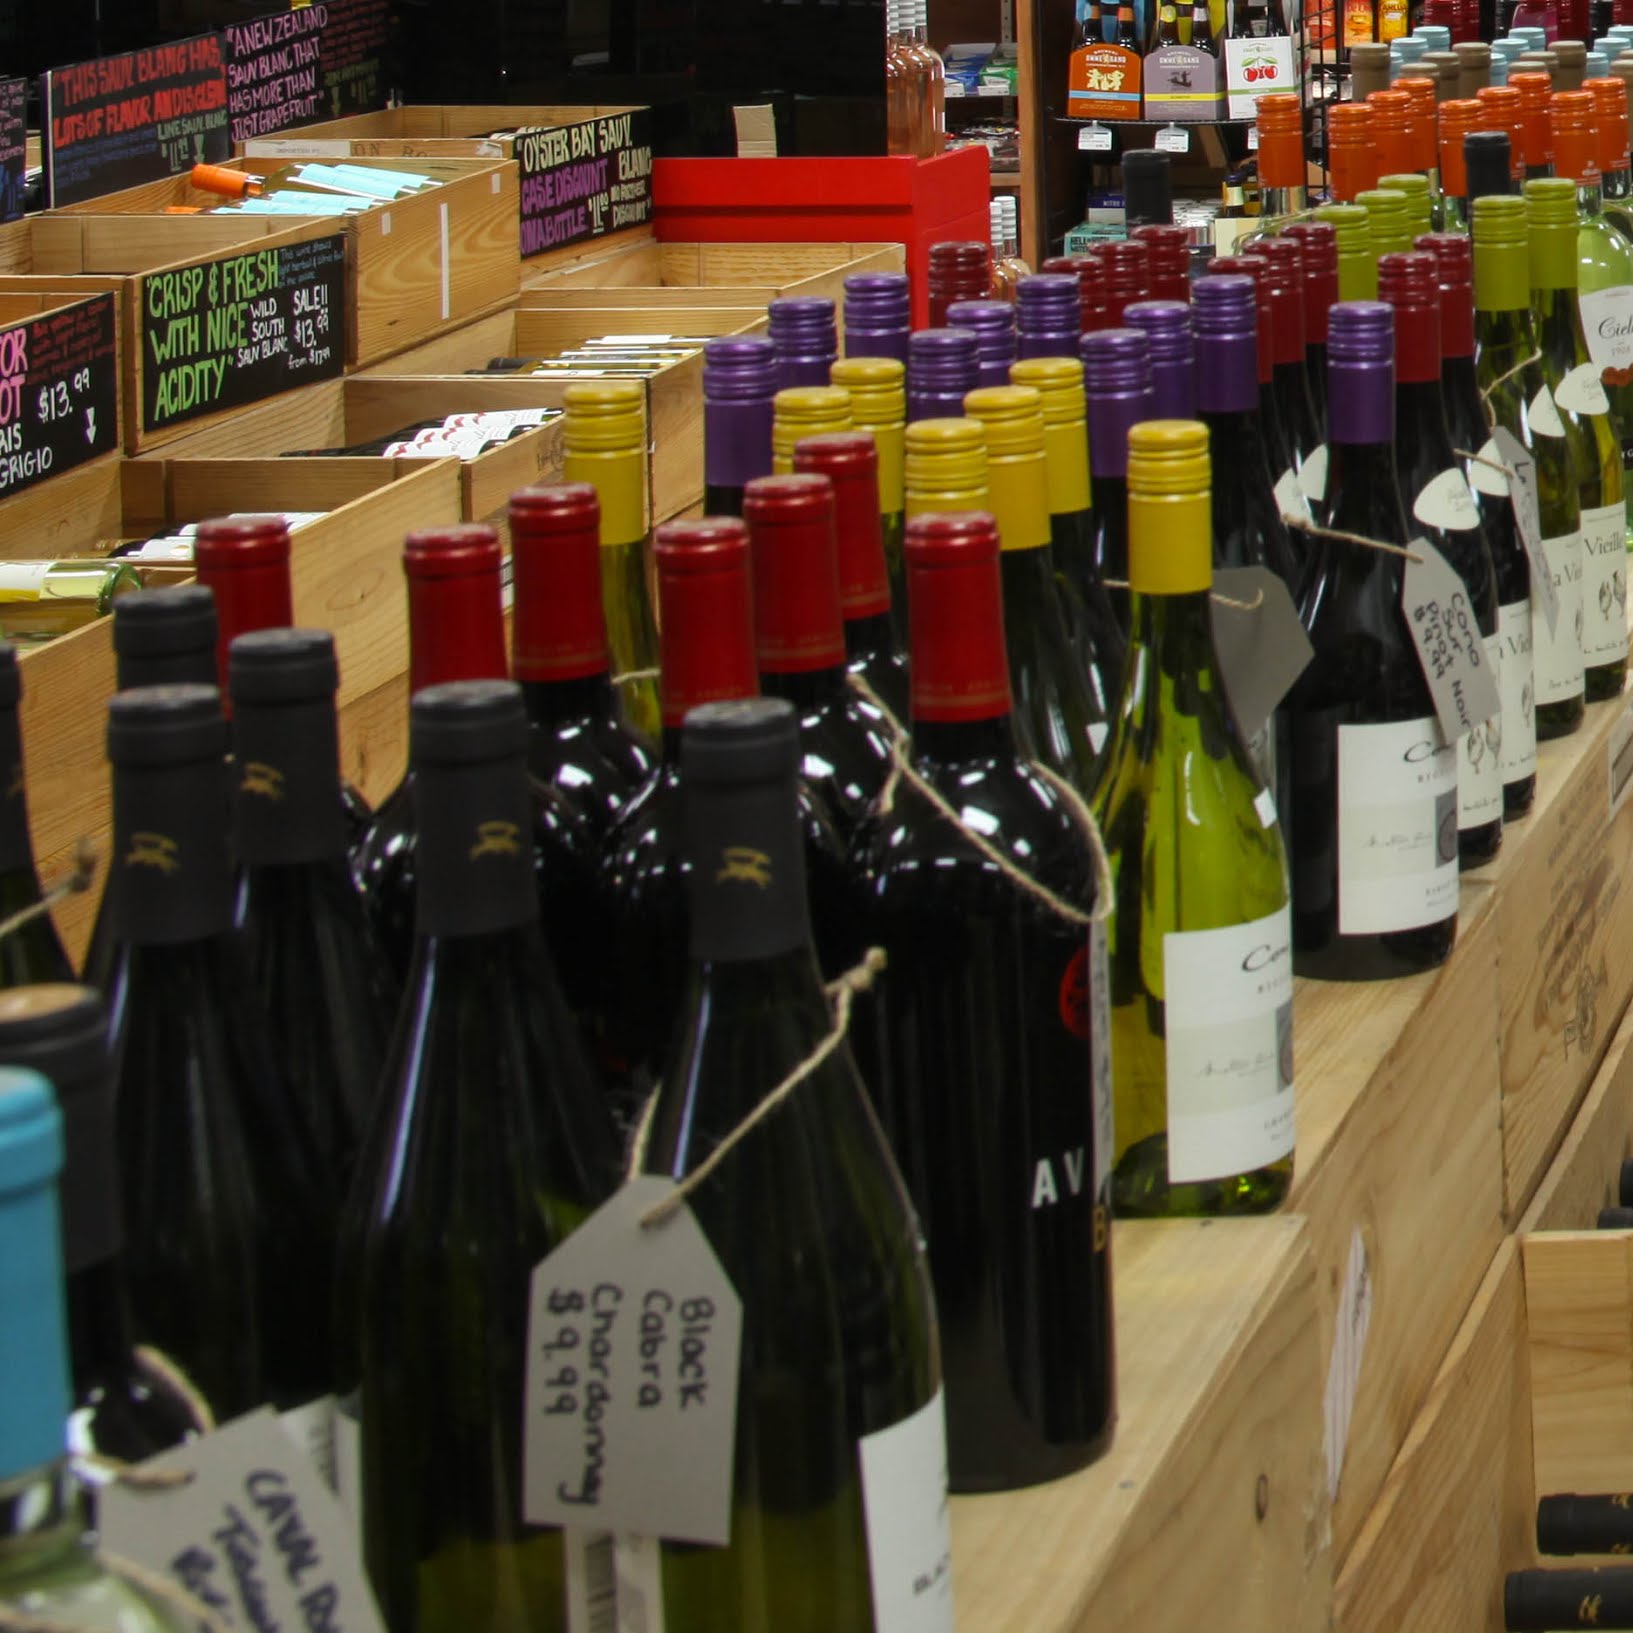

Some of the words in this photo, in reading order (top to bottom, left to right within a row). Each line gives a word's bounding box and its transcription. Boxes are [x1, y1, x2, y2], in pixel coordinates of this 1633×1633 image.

[247, 21, 273, 53] NEW
[273, 5, 328, 43] ZEALAND
[258, 48, 292, 79] BLANC
[292, 37, 321, 68] THAT
[229, 90, 252, 114] HAS
[252, 78, 285, 107] MORE
[285, 67, 317, 95] THAN
[230, 115, 258, 143] JUST
[571, 122, 596, 159] BAY
[619, 146, 652, 181] BLANC
[522, 174, 556, 215] CASE
[208, 263, 219, 308] &
[223, 250, 279, 303] FRESH
[293, 284, 328, 316] SALE!!
[250, 297, 277, 318] WILD
[252, 317, 285, 342] SOUTH
[150, 314, 199, 365] WITH
[207, 301, 249, 353] NICE
[261, 336, 289, 359] BLANC
[38, 368, 90, 423] $13.99
[1427, 601, 1454, 668] Pinot
[1452, 592, 1479, 667] Cono
[639, 1290, 673, 1408] Cabra
[679, 1297, 715, 1410] Black
